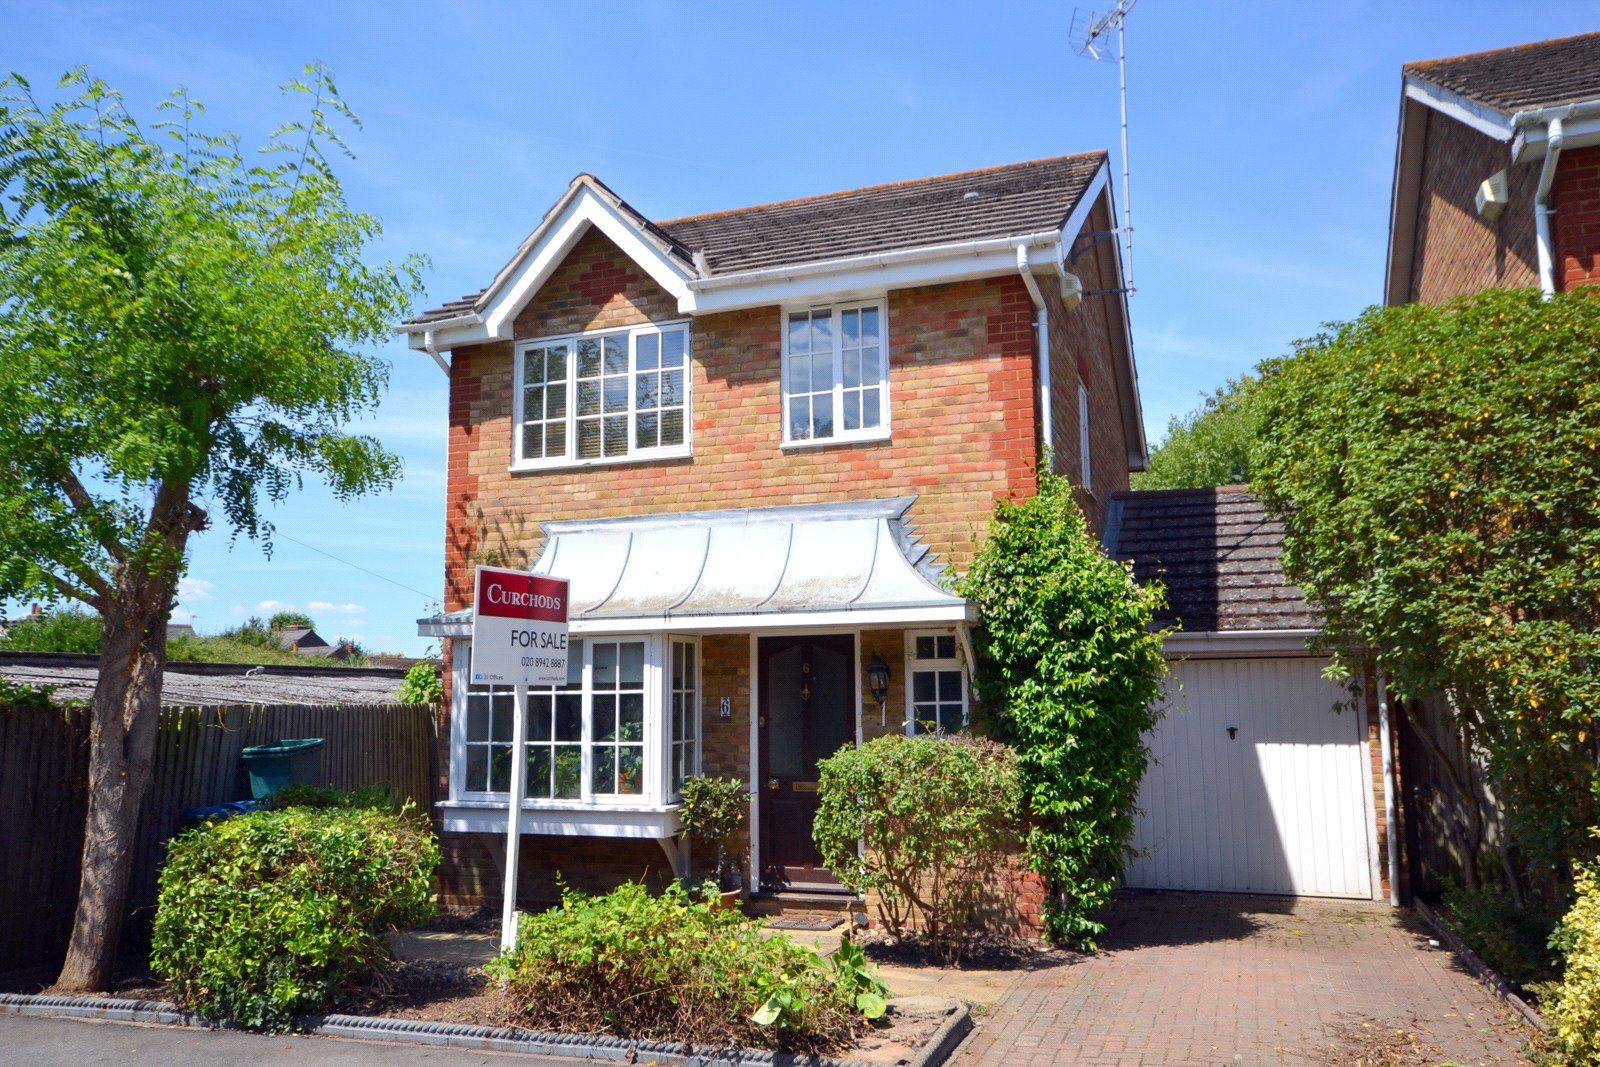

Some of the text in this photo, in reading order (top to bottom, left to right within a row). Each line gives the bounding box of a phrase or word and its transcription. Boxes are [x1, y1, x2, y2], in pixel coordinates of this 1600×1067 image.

[487, 583, 561, 610] CURCHODS
[511, 630, 566, 650] FOR SALE
[521, 656, 565, 668] 020 8942 8887
[803, 664, 810, 673] 6
[721, 699, 729, 714] 6
